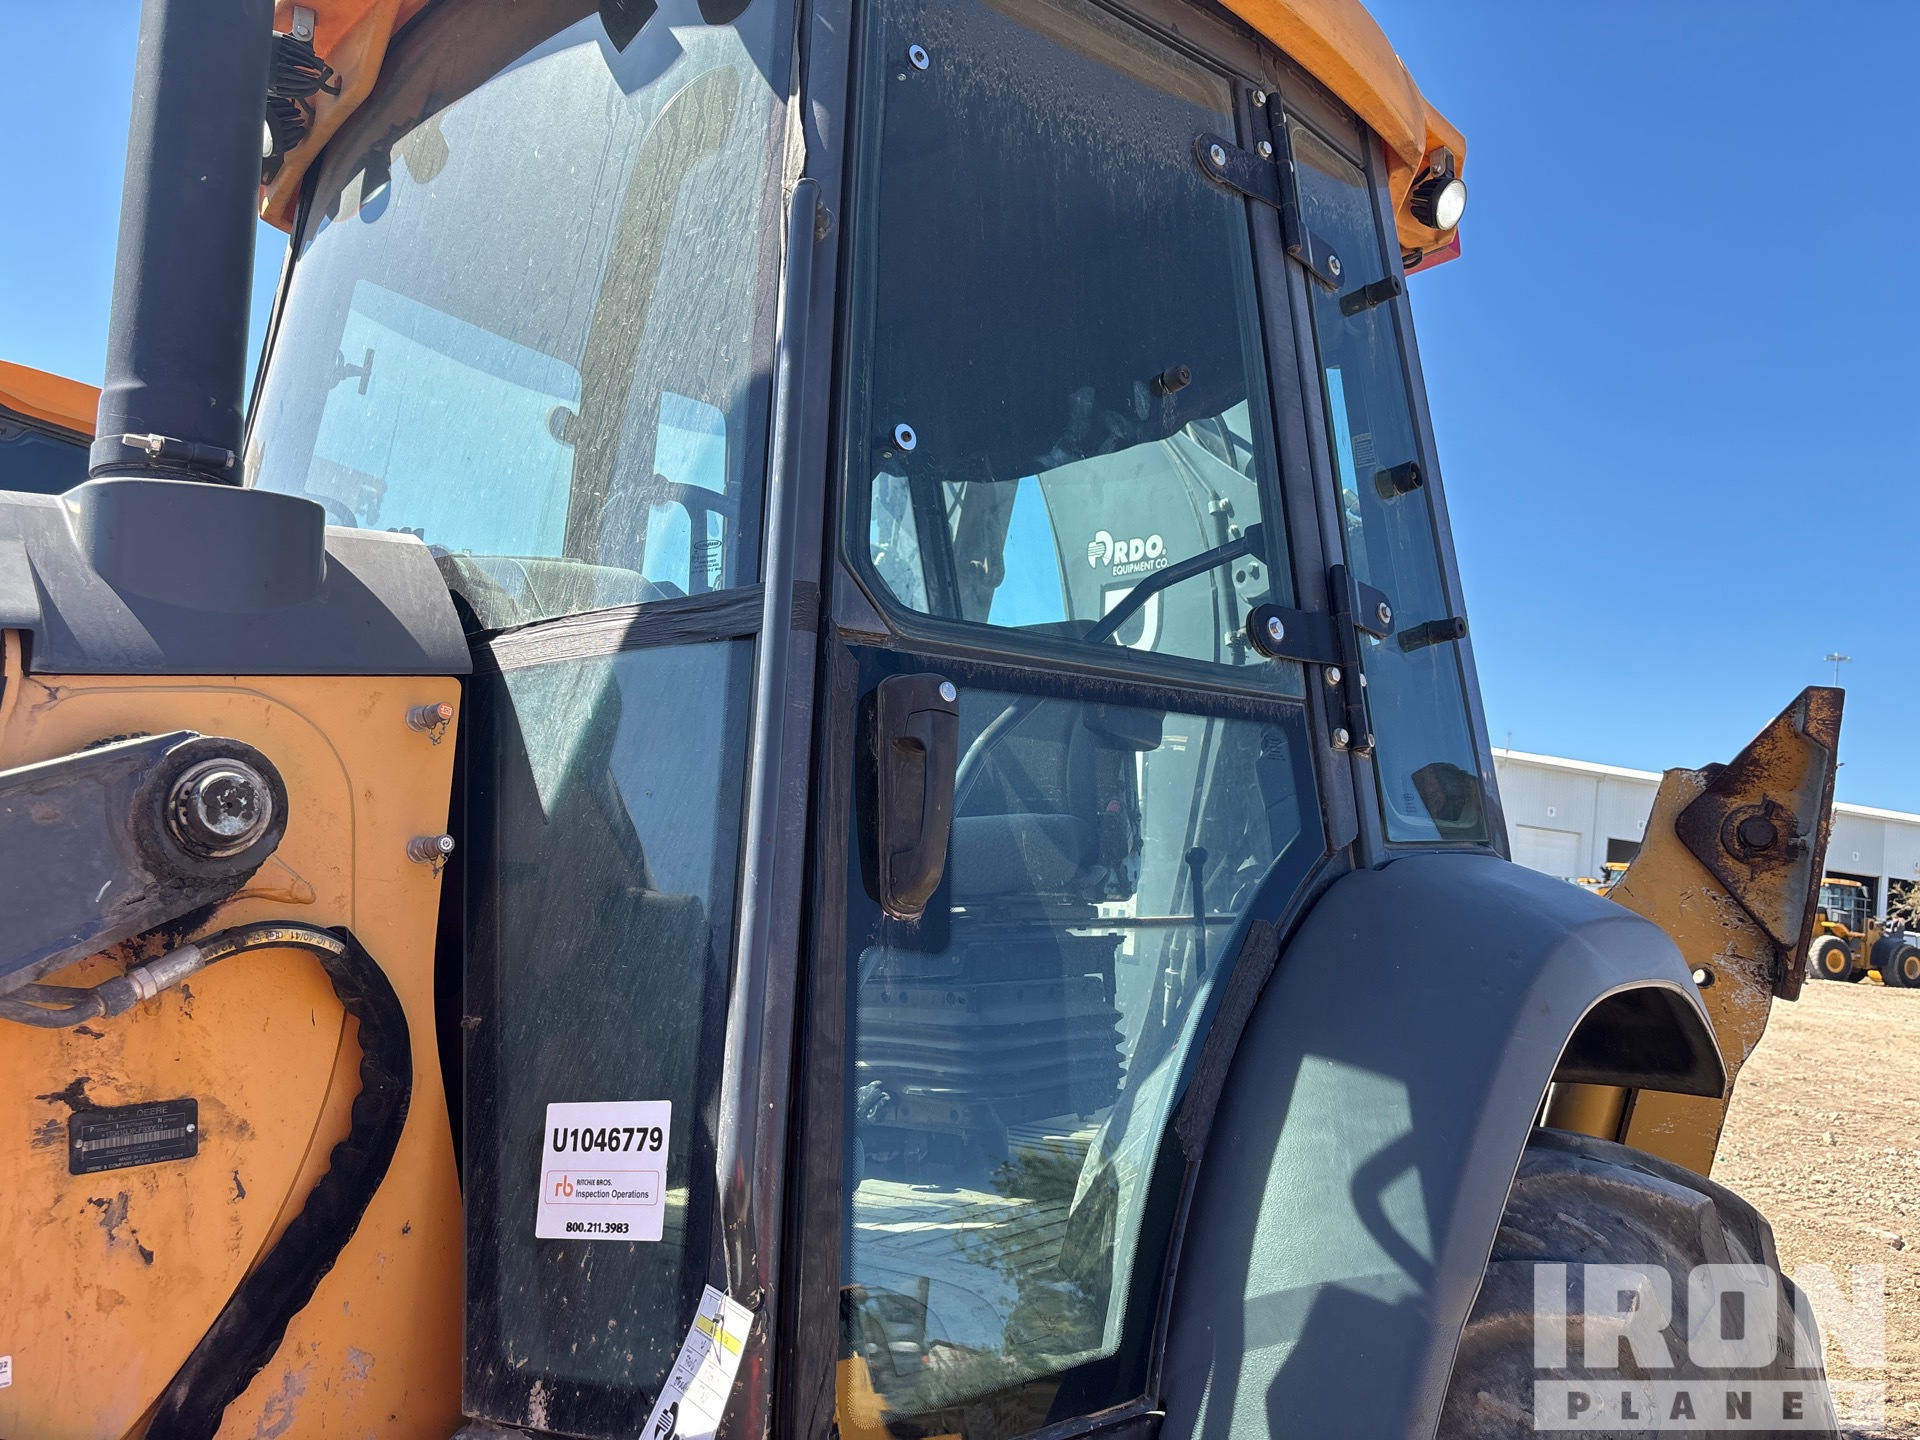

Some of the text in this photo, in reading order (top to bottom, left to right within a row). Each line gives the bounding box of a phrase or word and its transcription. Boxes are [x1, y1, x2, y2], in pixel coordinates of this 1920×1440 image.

[1112, 557, 1170, 576] EQUIPMENT CO.
[136, 1105, 168, 1117] DEERE
[552, 1126, 664, 1153] U1046779
[576, 1178, 613, 1187] RITCHIE BROS.
[575, 1189, 650, 1201] Inspection Operations
[565, 1221, 630, 1234] 800.211.3983
